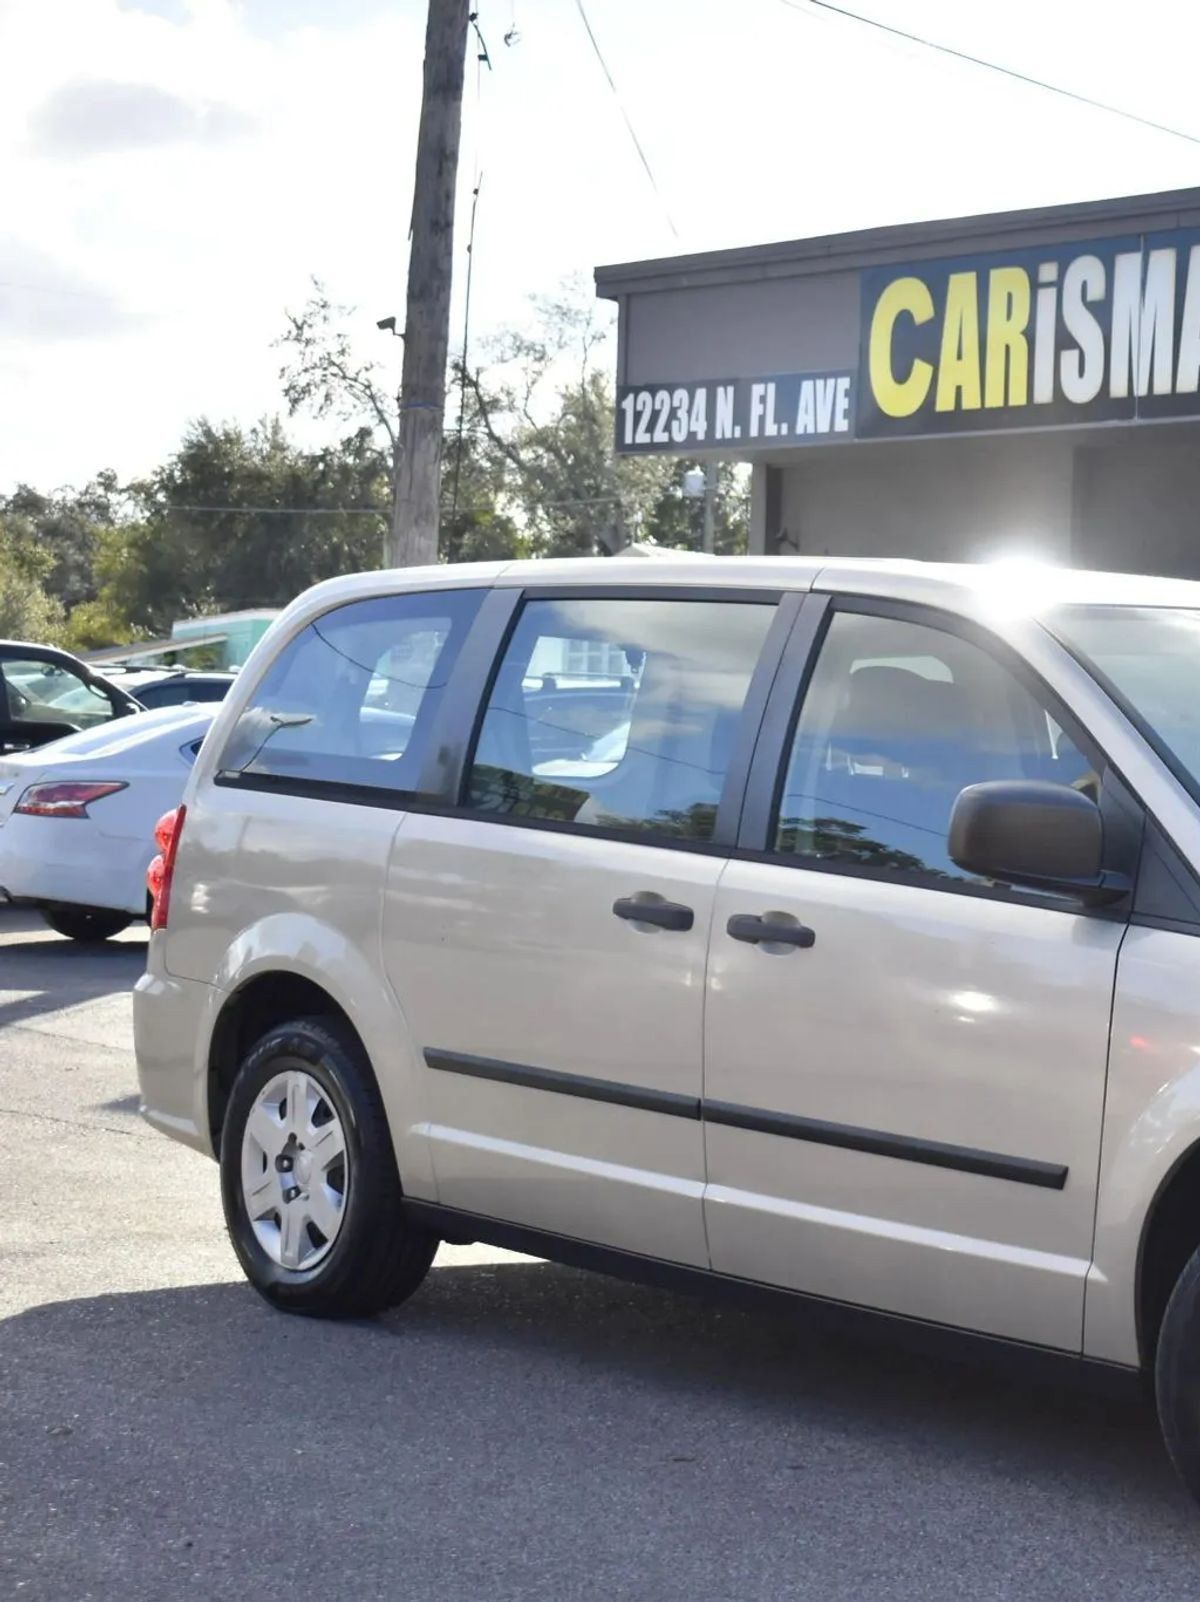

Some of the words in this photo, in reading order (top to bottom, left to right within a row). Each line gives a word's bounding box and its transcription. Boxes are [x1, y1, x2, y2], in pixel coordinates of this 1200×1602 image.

[621, 387, 708, 445] 12234
[714, 385, 742, 440] N.
[748, 380, 789, 438] FL.
[794, 376, 851, 436] AVE
